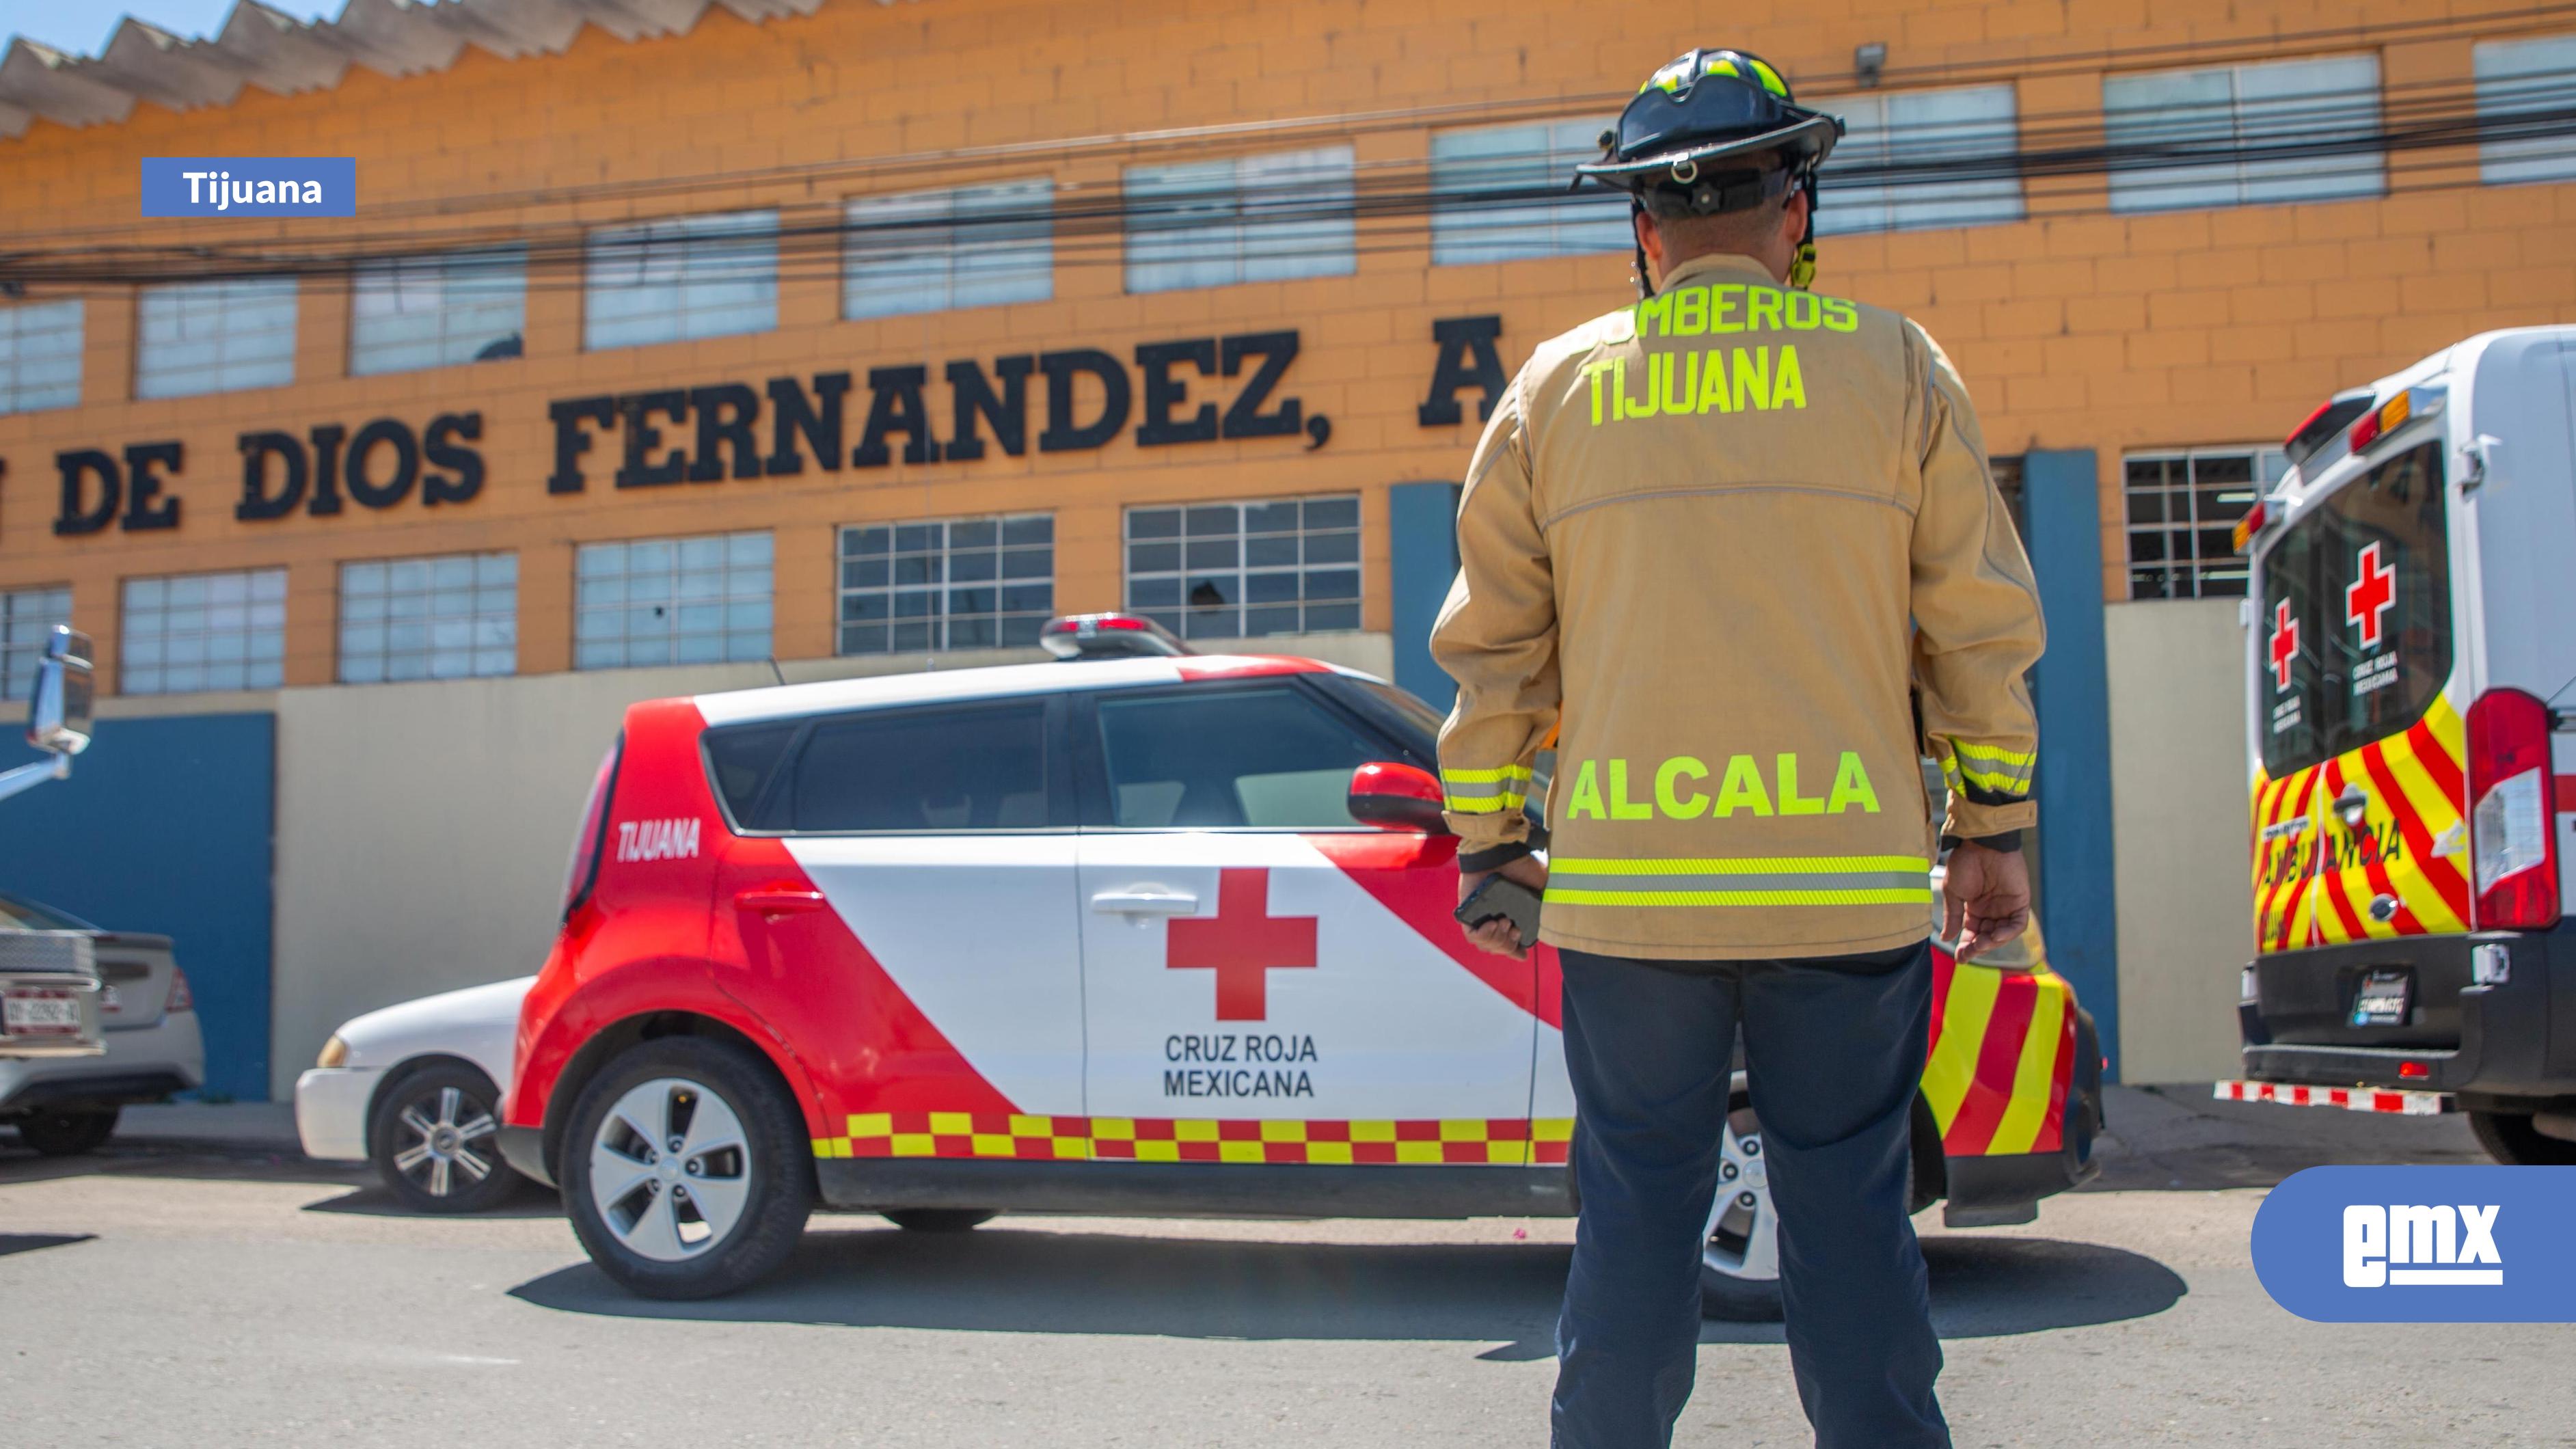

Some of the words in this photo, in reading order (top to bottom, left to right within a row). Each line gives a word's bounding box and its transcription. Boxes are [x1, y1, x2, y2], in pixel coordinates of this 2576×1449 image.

[1582, 345, 1806, 425] TIJUANA
[52, 441, 184, 537] DE
[235, 411, 486, 522] DIOS
[547, 330, 1332, 495] FERNANDEZ,
[1567, 751, 1880, 820] ALCALA
[616, 817, 701, 863] TIJUANA
[1165, 1034, 1237, 1063] CRUZ
[1245, 1034, 1318, 1064] ROJA
[1164, 1070, 1314, 1098] MEXICANA
